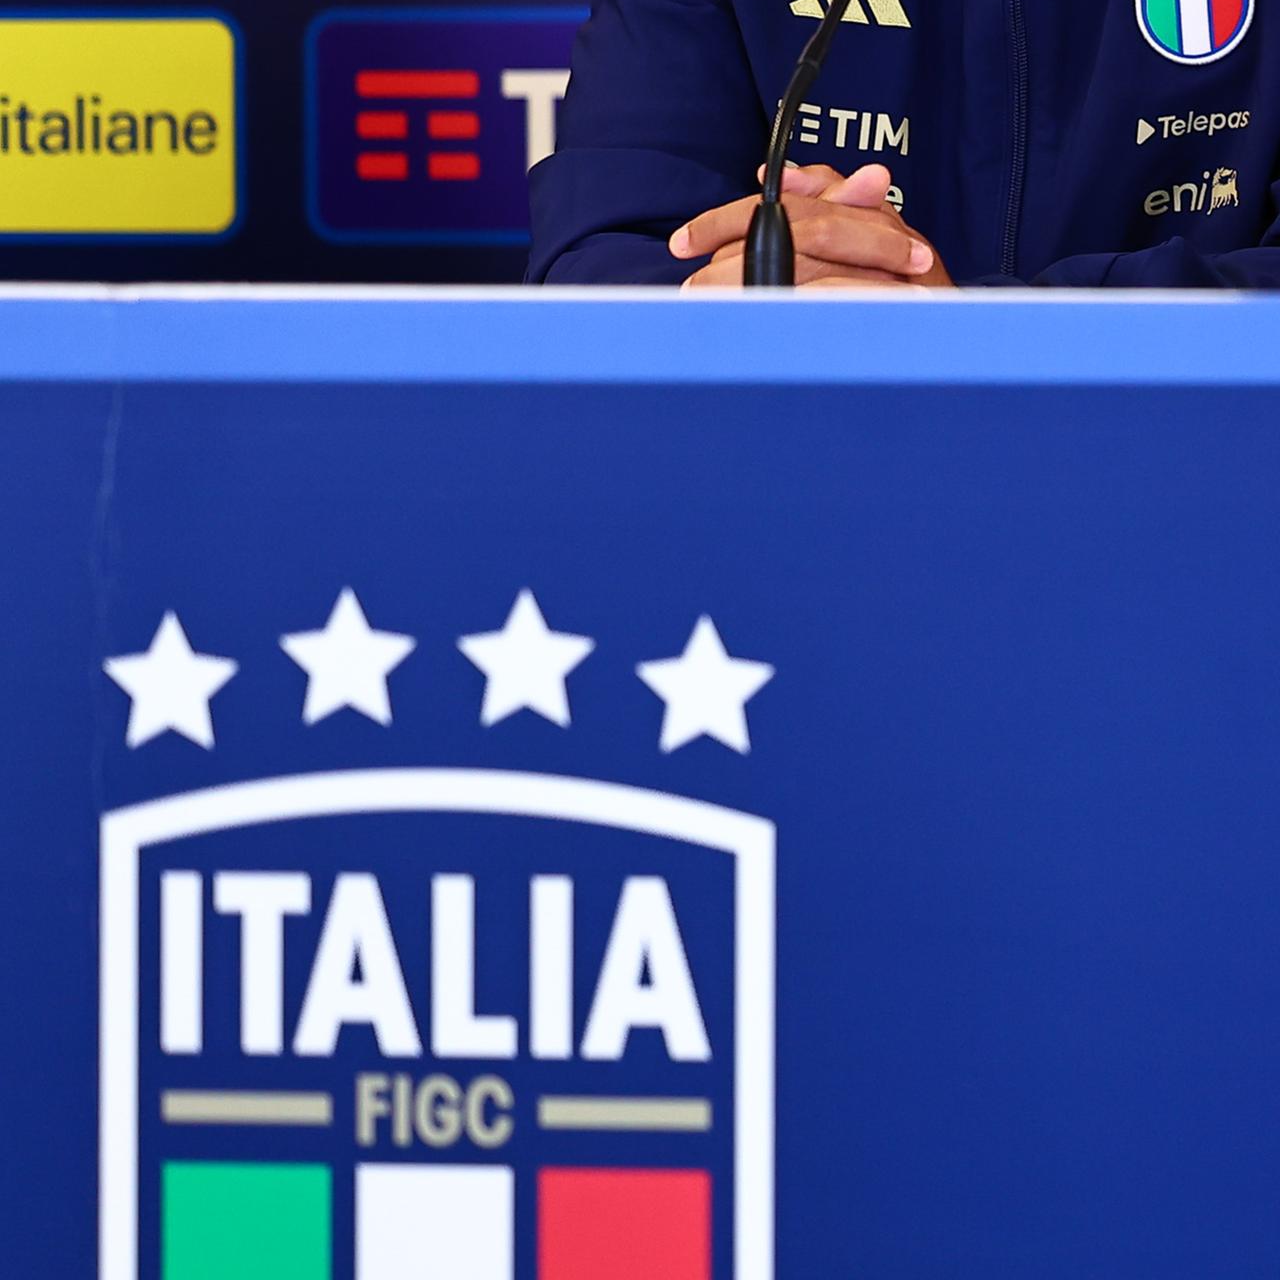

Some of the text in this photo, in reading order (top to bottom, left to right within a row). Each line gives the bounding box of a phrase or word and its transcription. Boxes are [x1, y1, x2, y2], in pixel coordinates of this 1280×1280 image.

[830, 108, 909, 156] TIM
[1158, 111, 1251, 138] Telepas
[1143, 171, 1210, 216] eni
[160, 871, 713, 1062] ITALIA
[354, 1073, 515, 1148] FIGC
